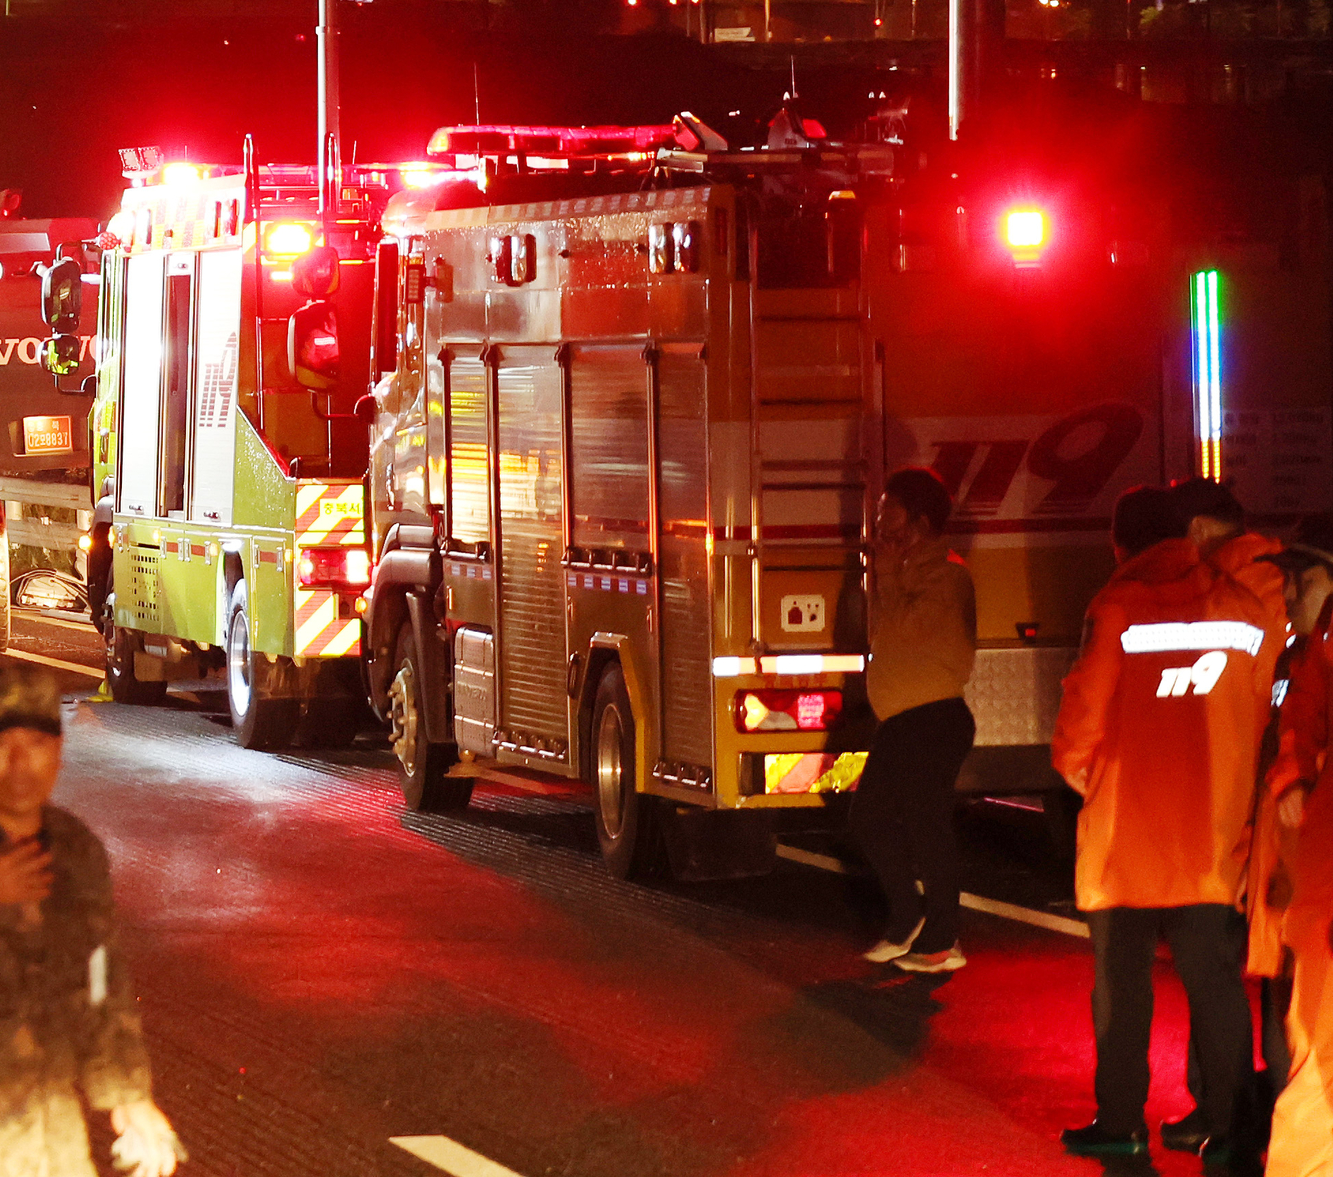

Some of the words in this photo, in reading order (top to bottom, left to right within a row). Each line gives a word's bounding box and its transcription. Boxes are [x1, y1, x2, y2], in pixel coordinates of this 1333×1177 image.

[199, 331, 237, 428] 119
[931, 403, 1144, 515] 119
[1155, 651, 1228, 698] 119
